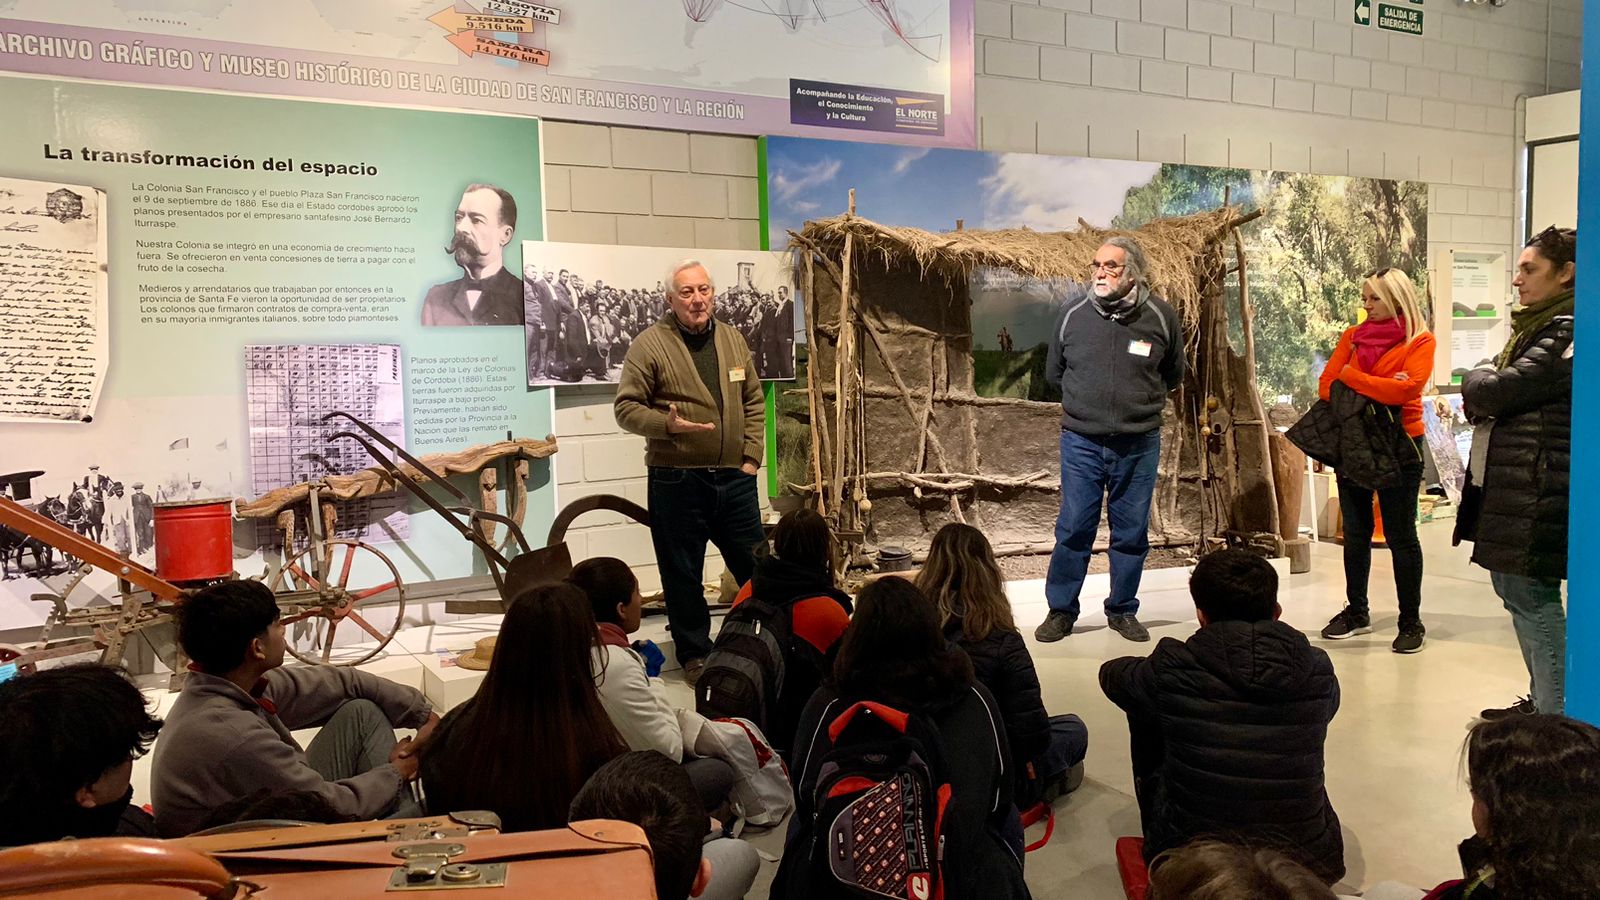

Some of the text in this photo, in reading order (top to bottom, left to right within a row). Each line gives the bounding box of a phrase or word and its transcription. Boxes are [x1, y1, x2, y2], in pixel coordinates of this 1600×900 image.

[487, 2, 549, 21] 12.327 km
[1384, 7, 1418, 21] SALIDA DE
[465, 16, 526, 24] LISBOA
[506, 23, 523, 31] km
[1380, 17, 1421, 32] EMERGENCIA
[476, 37, 545, 56] SAMARA
[476, 44, 538, 62] 14.176 km
[0, 32, 744, 120] ARCHIVO GRÁFICO Y MUSEO HISTÓRICO DE LA CIUDAD DE SAN FRANCISCO Y LA REGIÓN
[797, 88, 846, 99] Acompañando
[856, 94, 893, 104] Educación,
[827, 101, 874, 111] Conocimiento
[840, 113, 866, 121] Cultura
[896, 108, 938, 119] EL NORTE
[44, 144, 378, 176] La transformación del espacio
[131, 182, 144, 191] La
[146, 183, 183, 193] Colonia
[185, 184, 204, 194] San
[206, 185, 250, 196] Francisco
[259, 188, 267, 196] el
[269, 189, 299, 199] pueblo
[300, 189, 324, 199] Plaza
[326, 190, 343, 199] San
[345, 191, 384, 201] Francisco
[132, 194, 142, 203] el
[152, 195, 165, 204] de
[167, 196, 218, 207] septiembre
[220, 198, 232, 206] de
[262, 199, 279, 208] Ese
[296, 201, 304, 209] el
[306, 201, 336, 210] Estado
[406, 204, 418, 213] los
[133, 207, 165, 217] planos
[168, 209, 224, 218] presentados
[226, 211, 241, 220] por
[243, 210, 251, 219] el
[254, 212, 301, 222] empresario
[304, 212, 352, 222] santafesino
[374, 214, 411, 223] Bernardo
[136, 240, 173, 248] Nuestra
[175, 240, 210, 249] Colonia
[226, 241, 256, 252] integró
[334, 243, 344, 252] de
[166, 252, 179, 260] Se
[182, 252, 227, 261] ofrecieron
[243, 254, 268, 262] venta
[269, 254, 322, 263] concesiones
[324, 254, 335, 263] de
[337, 255, 358, 263] tierra
[367, 257, 390, 266] pagar
[137, 263, 159, 272] fruto
[161, 263, 174, 272] de
[176, 264, 184, 272] la
[138, 284, 182, 293] Medieros
[192, 284, 252, 293] arrendatarios
[253, 286, 270, 295] que
[272, 284, 317, 295] trabajaban
[320, 286, 333, 295] por
[335, 285, 372, 293] entonces
[386, 285, 394, 293] la
[139, 294, 182, 305] provincia
[184, 294, 196, 303] de
[198, 294, 225, 303] Santa
[227, 294, 239, 303] Fe
[241, 294, 268, 303] vieron
[270, 294, 278, 303] la
[280, 294, 330, 305] oportunidad
[332, 294, 342, 303] de
[140, 304, 158, 313] Los
[160, 304, 196, 313] colonos
[198, 306, 216, 315] que
[218, 304, 254, 313] firmaron
[256, 304, 296, 313] contratos
[298, 304, 309, 313] de
[209, 314, 260, 325] inmigrantes
[302, 314, 326, 322] sobre
[328, 314, 346, 322] todo
